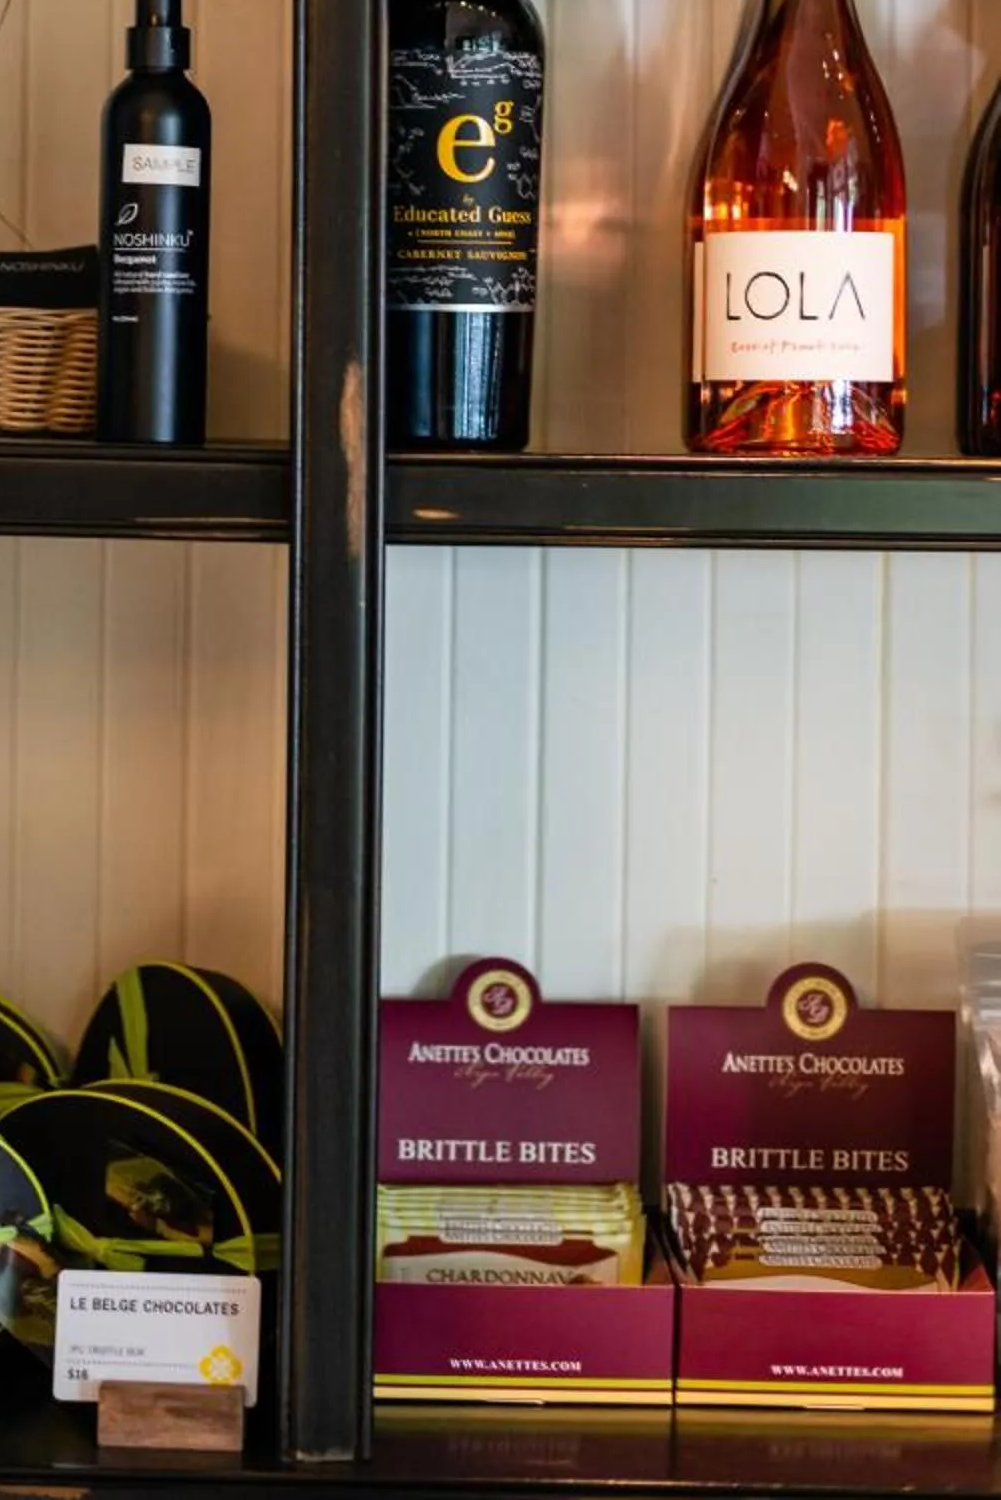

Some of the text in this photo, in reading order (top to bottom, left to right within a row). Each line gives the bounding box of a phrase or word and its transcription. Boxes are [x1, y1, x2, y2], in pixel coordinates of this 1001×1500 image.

[394, 205, 532, 224] Educated Guess
[113, 233, 190, 247] NOSHINKU
[397, 250, 461, 259] CABERNET
[726, 271, 865, 320] LOLA
[483, 1042, 590, 1066] CHOCOLATES
[798, 1052, 904, 1076] CHOCOLATES
[398, 1139, 596, 1164] BRITTLE BITES
[711, 1148, 910, 1171] BRITTLE BITES
[70, 1298, 240, 1316] LE BELGE CHOCOLATES
[449, 1359, 582, 1371] WWW.ANETTES.COM
[770, 1364, 904, 1378] WWW.ANETTES.COM
